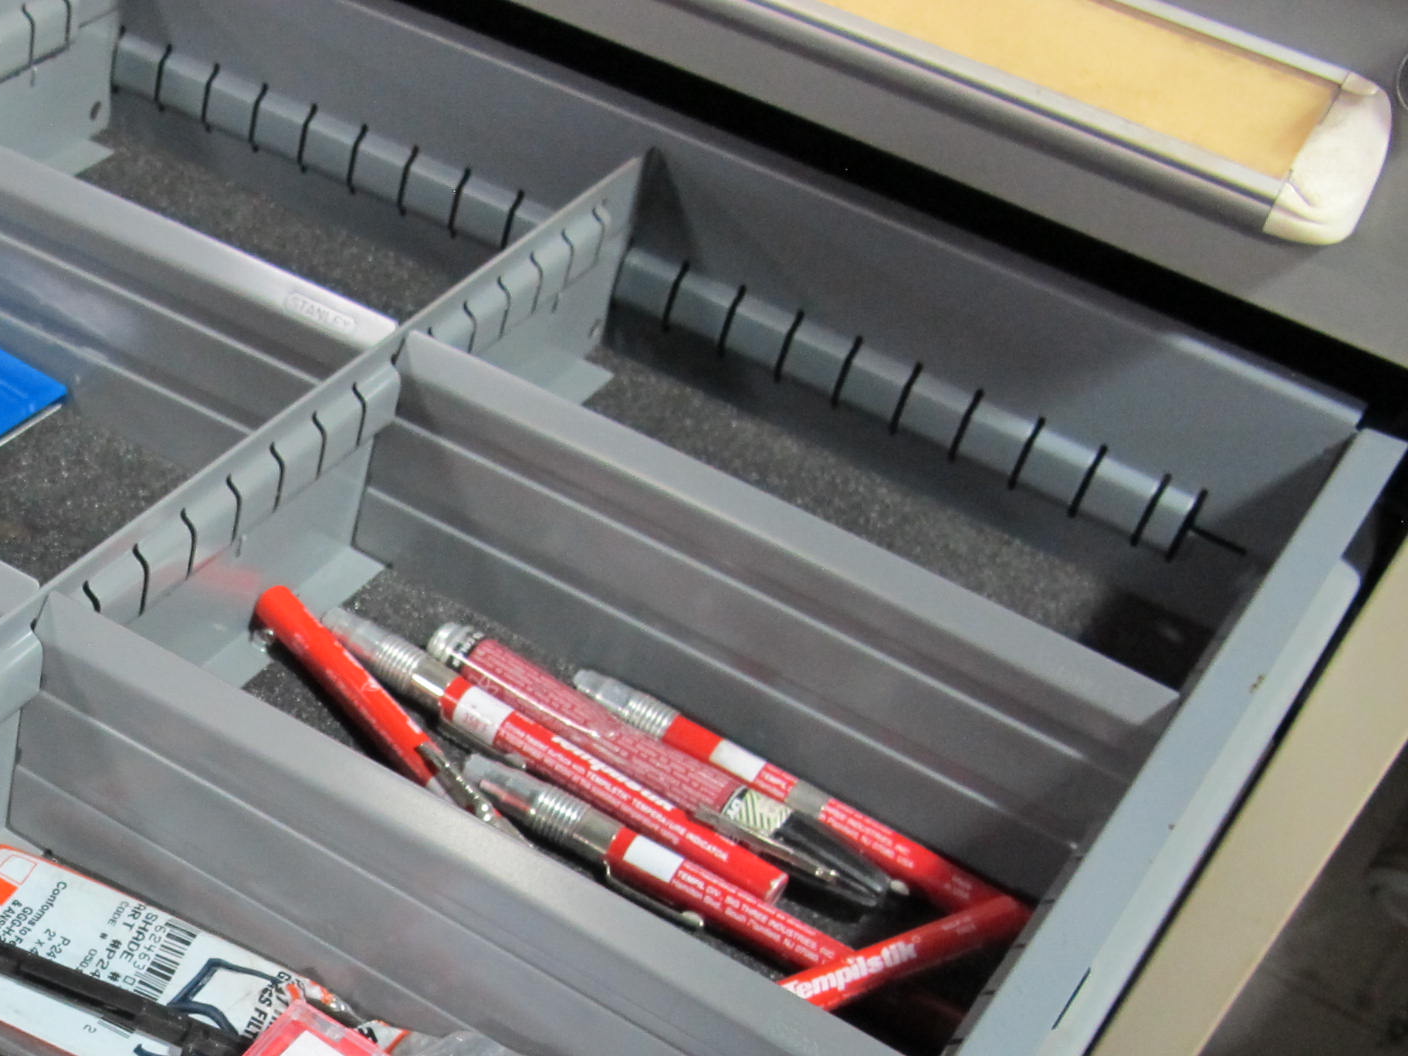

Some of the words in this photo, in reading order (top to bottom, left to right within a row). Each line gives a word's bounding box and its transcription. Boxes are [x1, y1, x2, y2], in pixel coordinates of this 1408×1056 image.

[28, 880, 67, 927] Conforms
[107, 900, 129, 926] CODE
[18, 926, 31, 936] to
[44, 935, 71, 963] P-24
[119, 912, 158, 962] SHADE
[132, 924, 168, 971] 62463
[782, 940, 918, 1000] Tempilstik
